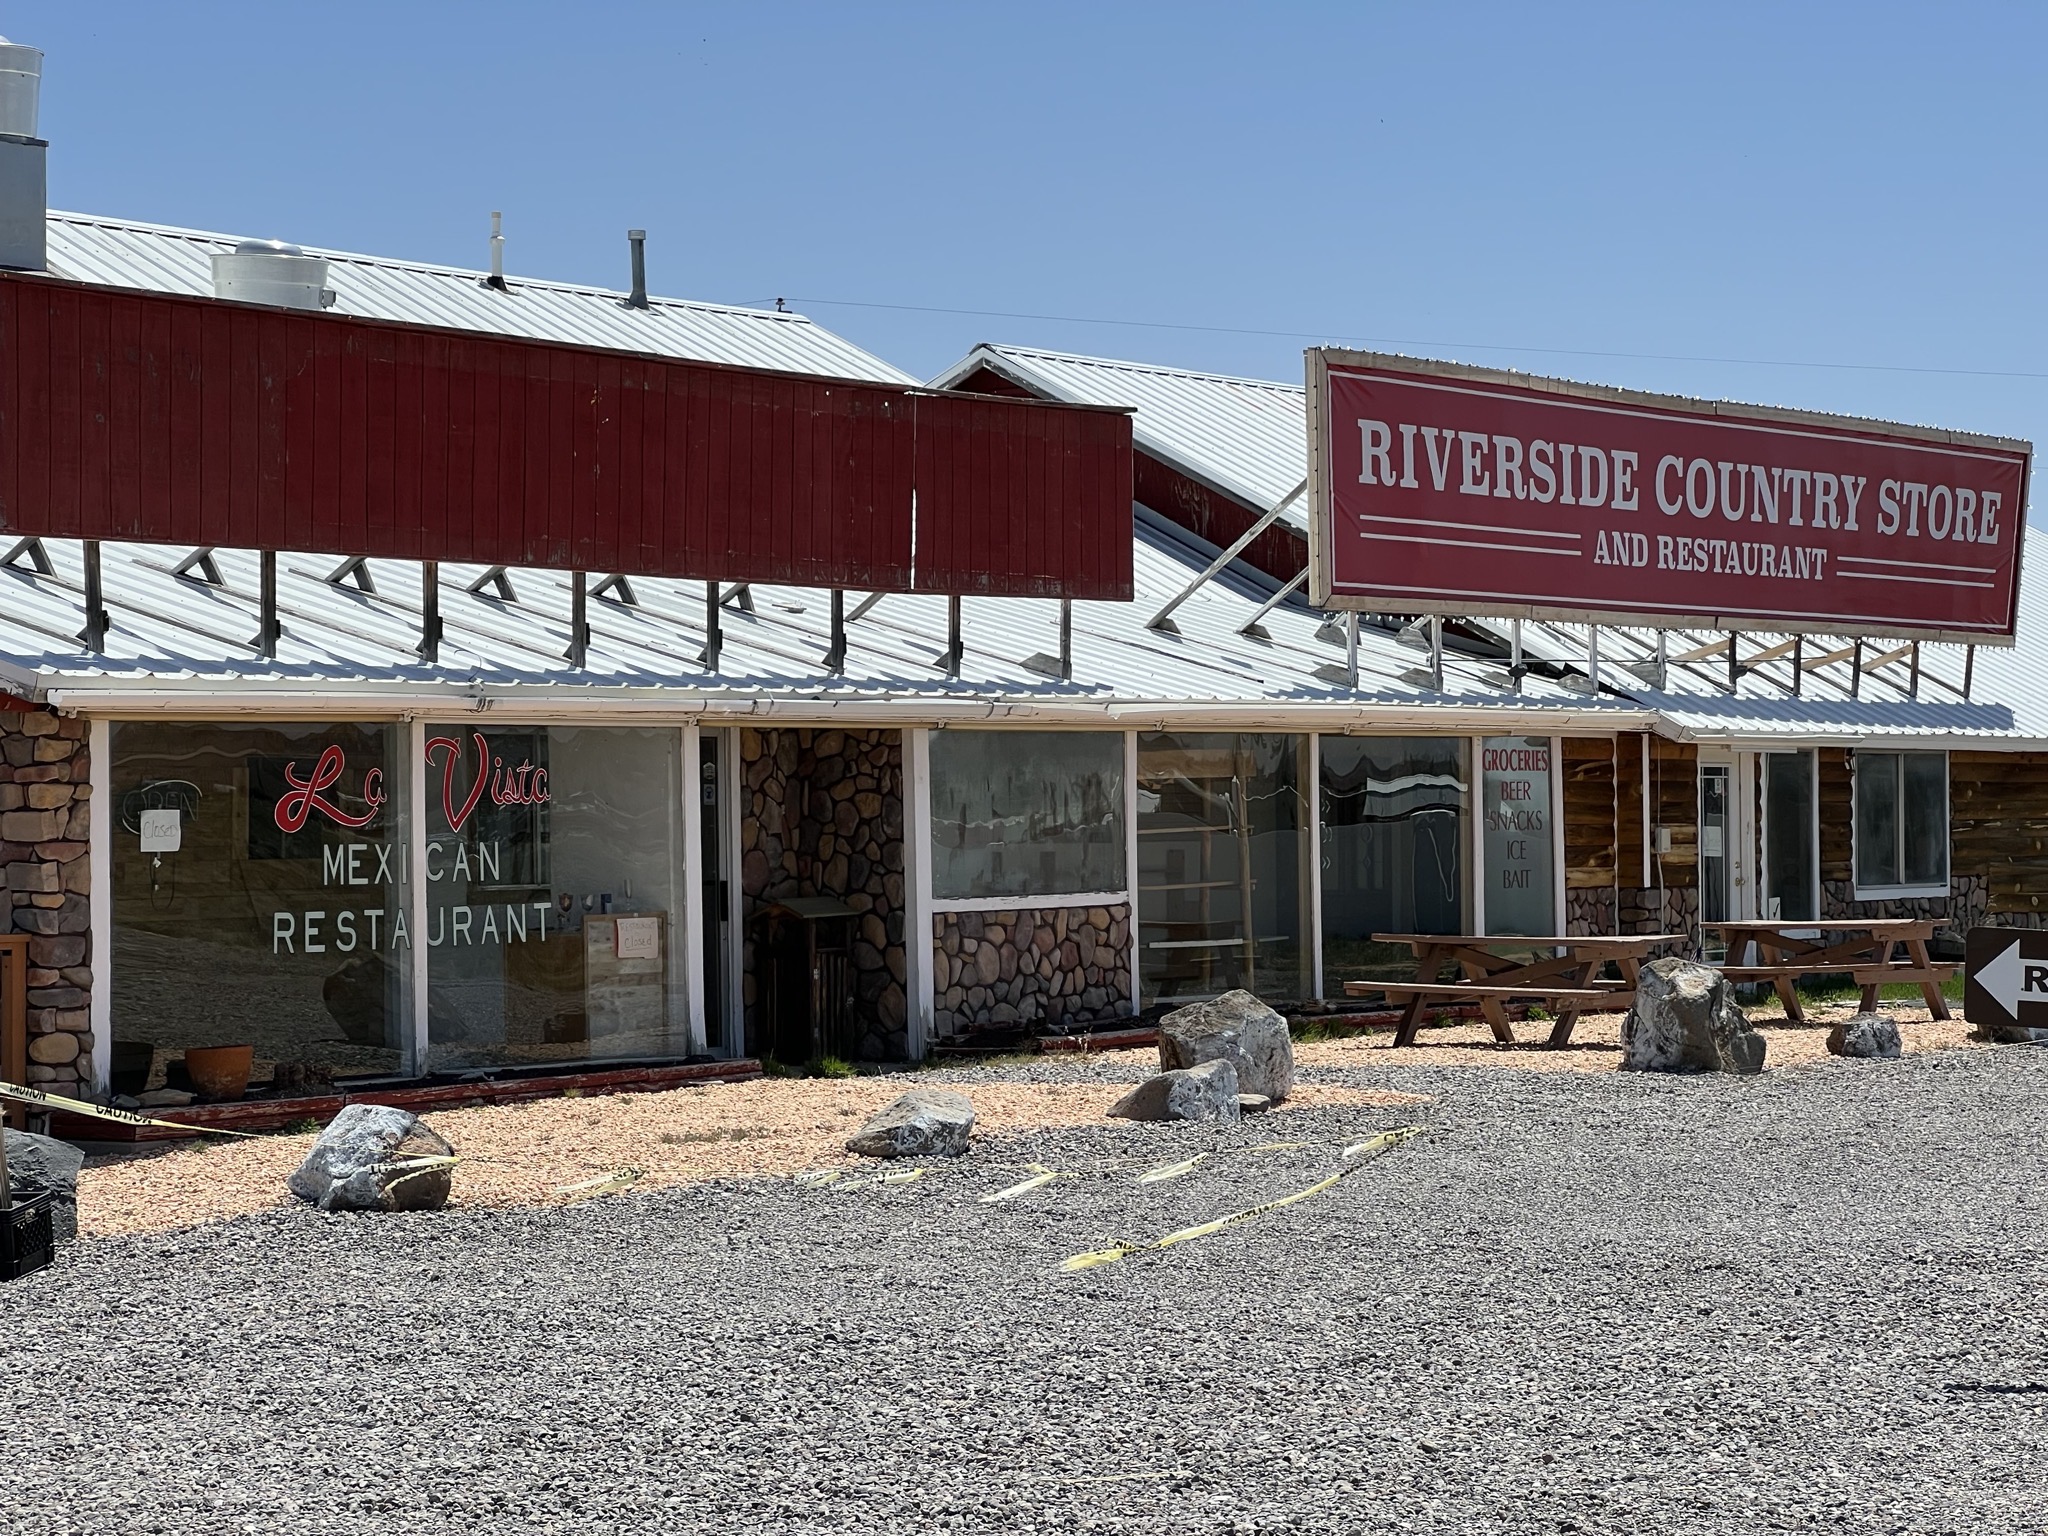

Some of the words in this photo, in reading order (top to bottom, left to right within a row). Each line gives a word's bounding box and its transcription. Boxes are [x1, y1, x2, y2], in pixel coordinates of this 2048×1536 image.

[1357, 418, 1639, 512] RIVERSIDE
[1655, 454, 1867, 532] COUNTRY
[1877, 478, 2002, 545] STORE
[1593, 529, 1649, 568] AND
[1656, 534, 1828, 581] RESTAURANT
[1482, 748, 1549, 772] GROCERIES
[274, 744, 387, 834] La
[424, 732, 551, 833] Vista
[1501, 781, 1532, 801] BEER
[1489, 810, 1543, 832] SNACKS
[322, 840, 501, 887] MEXICAN
[1507, 840, 1527, 860] ICE
[1503, 869, 1532, 889] BAIT
[273, 901, 552, 955] RESTAURANT
